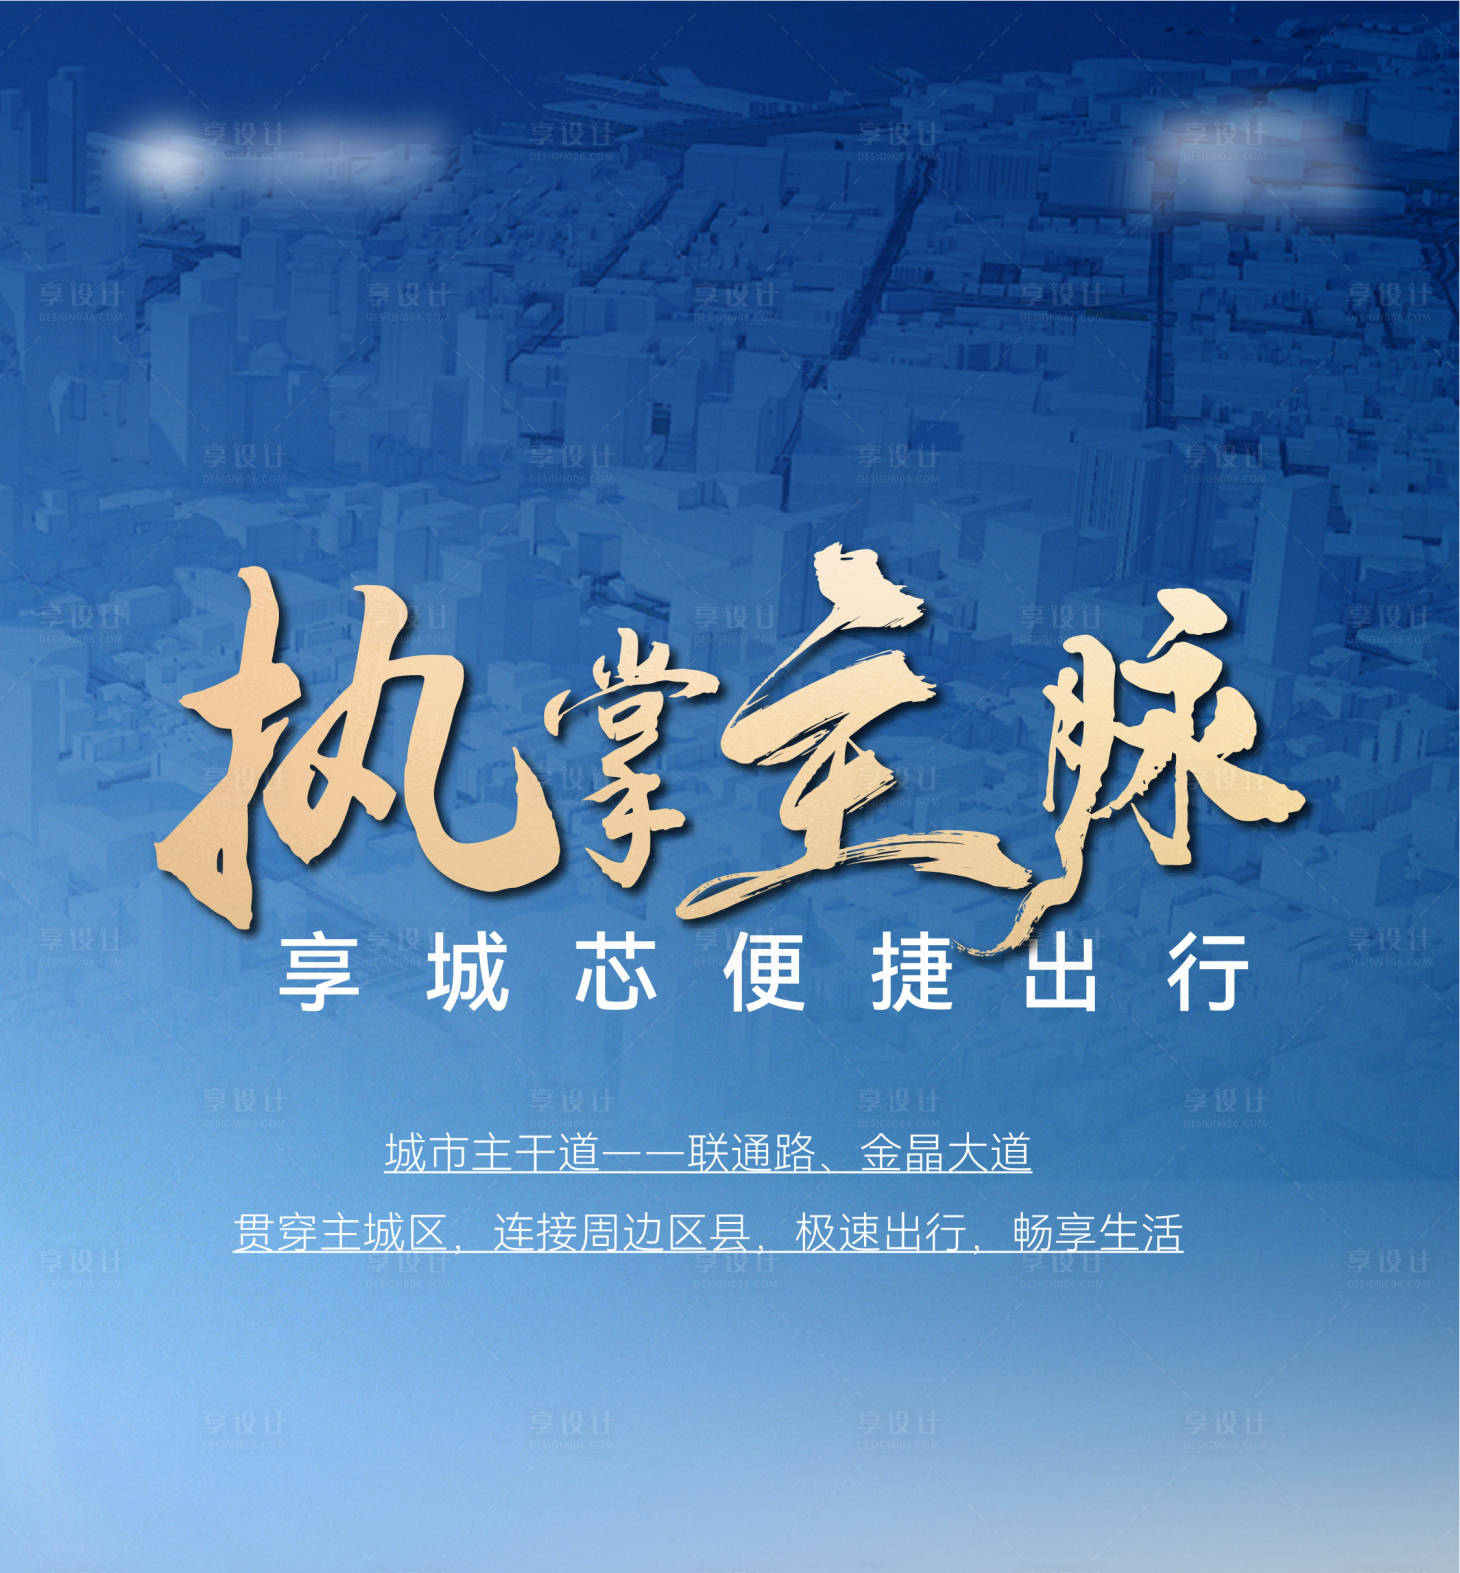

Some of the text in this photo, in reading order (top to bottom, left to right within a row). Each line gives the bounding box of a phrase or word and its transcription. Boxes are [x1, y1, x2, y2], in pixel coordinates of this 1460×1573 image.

[155, 541, 1306, 957] 执掌主脉
[279, 931, 1249, 1012] 享城芯便捷出行
[385, 1131, 1031, 1173] 城市主干道——联通路、金晶大道
